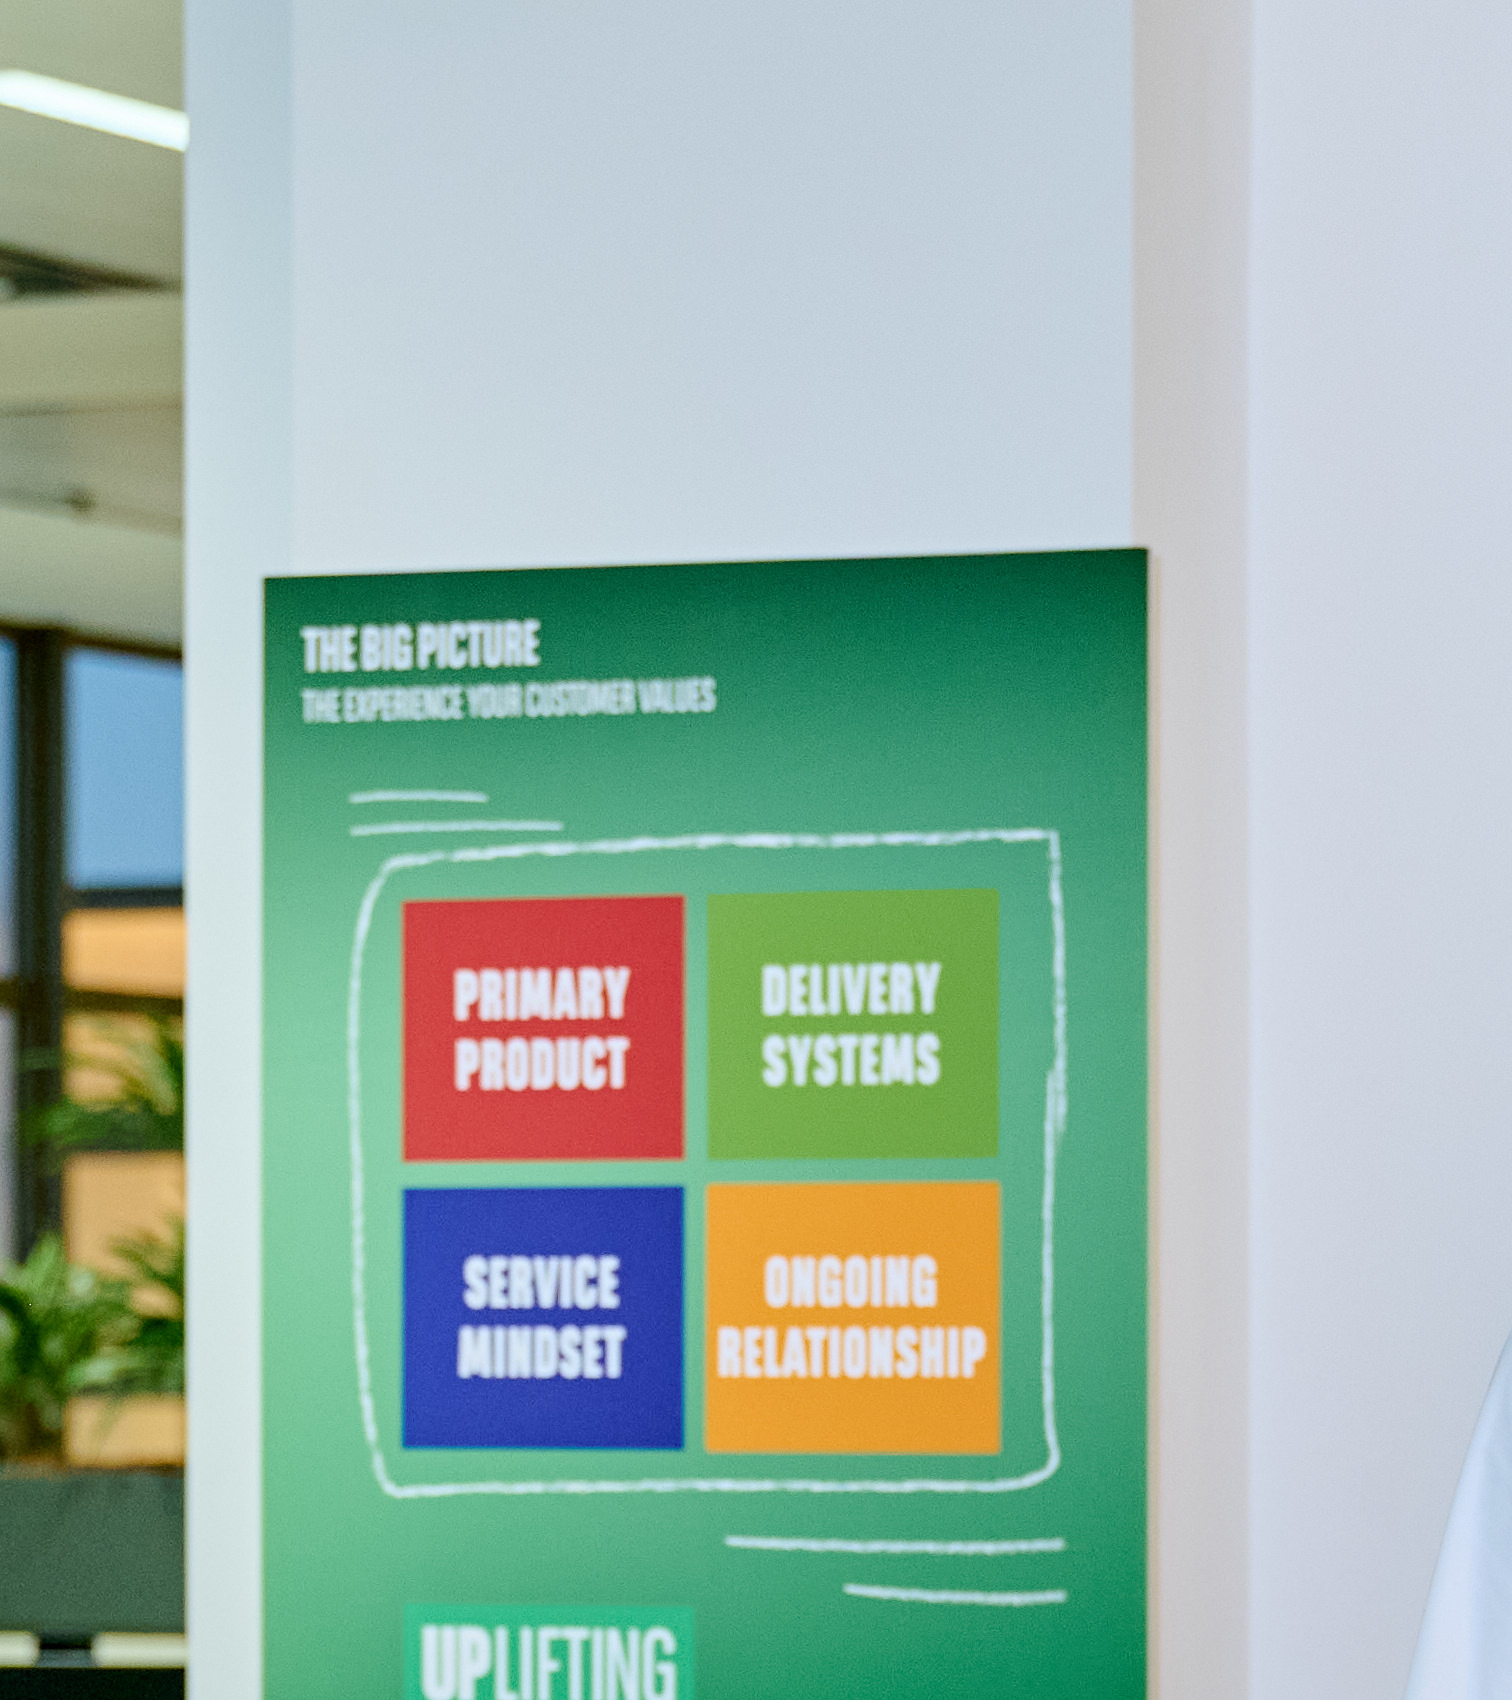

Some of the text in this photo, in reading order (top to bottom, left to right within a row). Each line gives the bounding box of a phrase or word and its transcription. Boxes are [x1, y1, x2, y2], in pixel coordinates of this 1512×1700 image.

[301, 619, 541, 673] THE BIG PICTURE
[301, 677, 717, 724] THE EXPERIENCE YOUR CUSTOMER VALUES
[453, 966, 630, 1021] PRIMARY
[762, 962, 941, 1017] DELIVERY
[454, 1037, 629, 1091] PRODUCT
[762, 1033, 941, 1087] SYSTEMS
[463, 1254, 621, 1311] SERVICE
[764, 1254, 938, 1309] ONGOING
[457, 1325, 627, 1380] MINDSET
[716, 1326, 987, 1380] RELATIONSHIP
